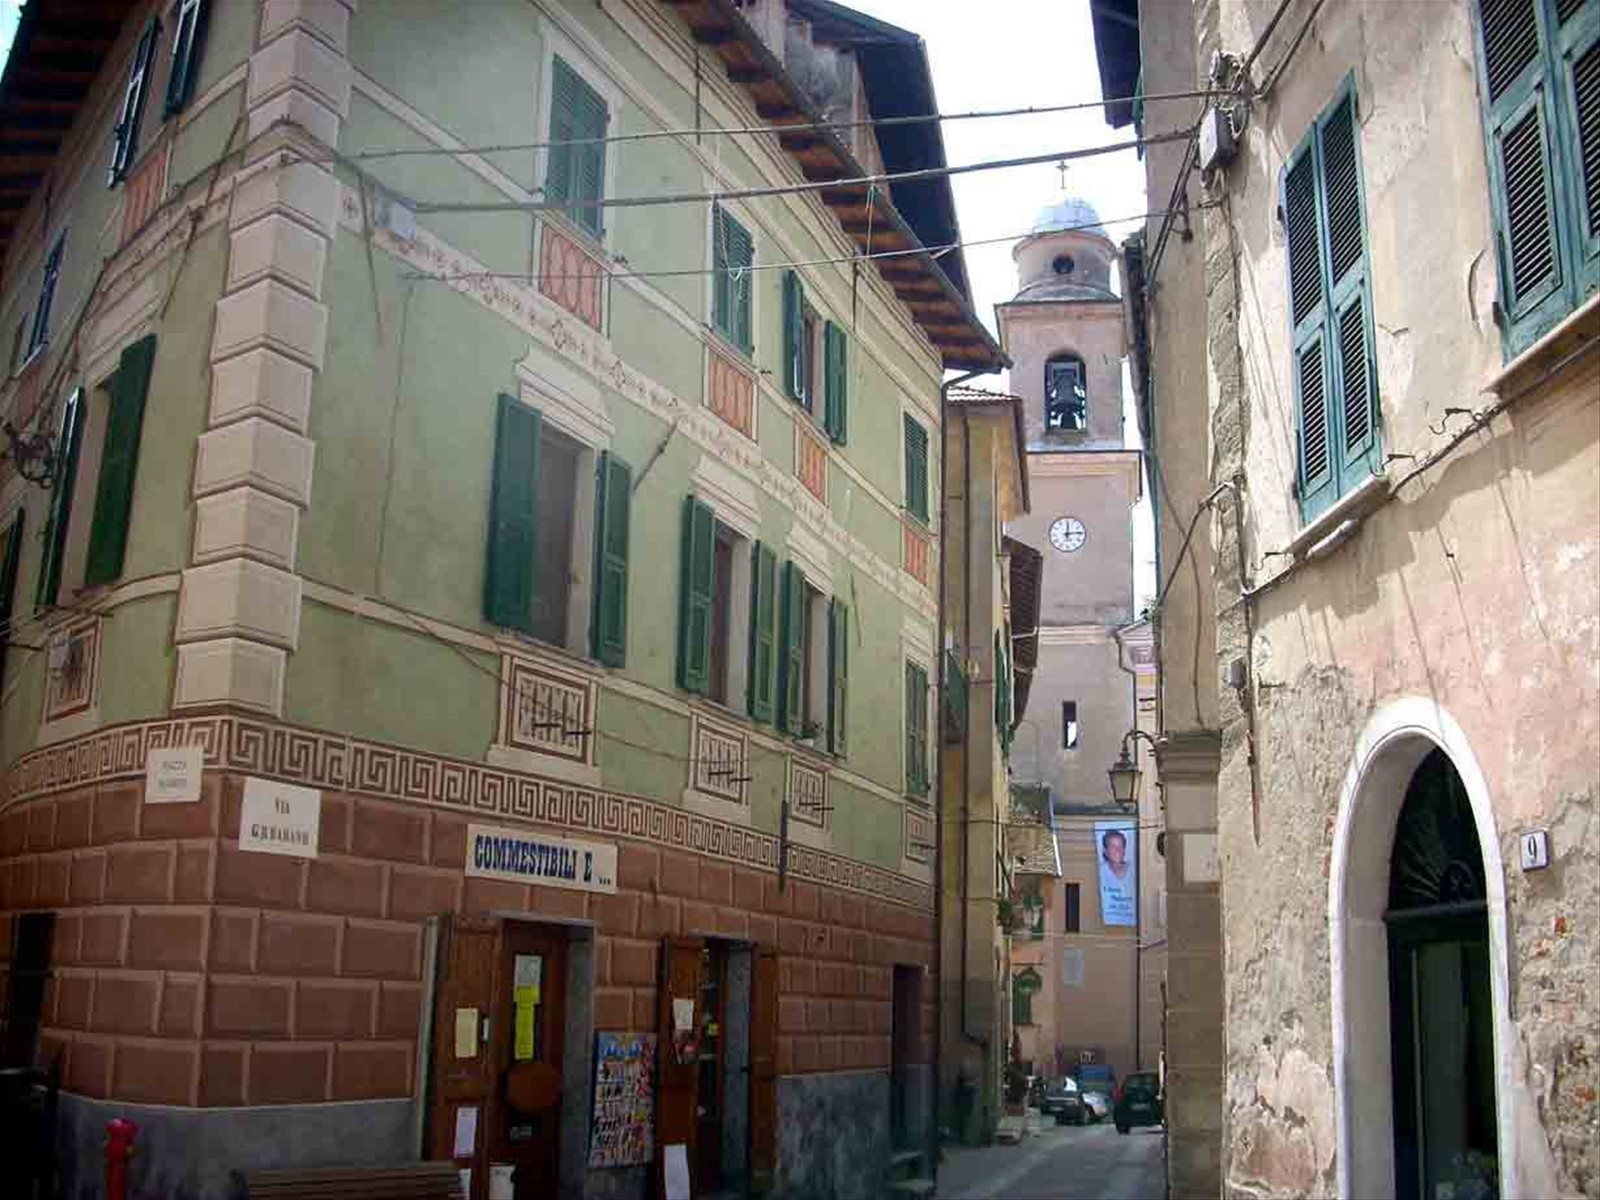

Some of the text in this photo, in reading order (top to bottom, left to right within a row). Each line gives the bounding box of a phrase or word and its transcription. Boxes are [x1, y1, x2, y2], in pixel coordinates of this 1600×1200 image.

[275, 796, 290, 814] VIA
[475, 835, 577, 879] COMMESTIBILI
[583, 851, 593, 882] E
[1527, 835, 1538, 865] 9
